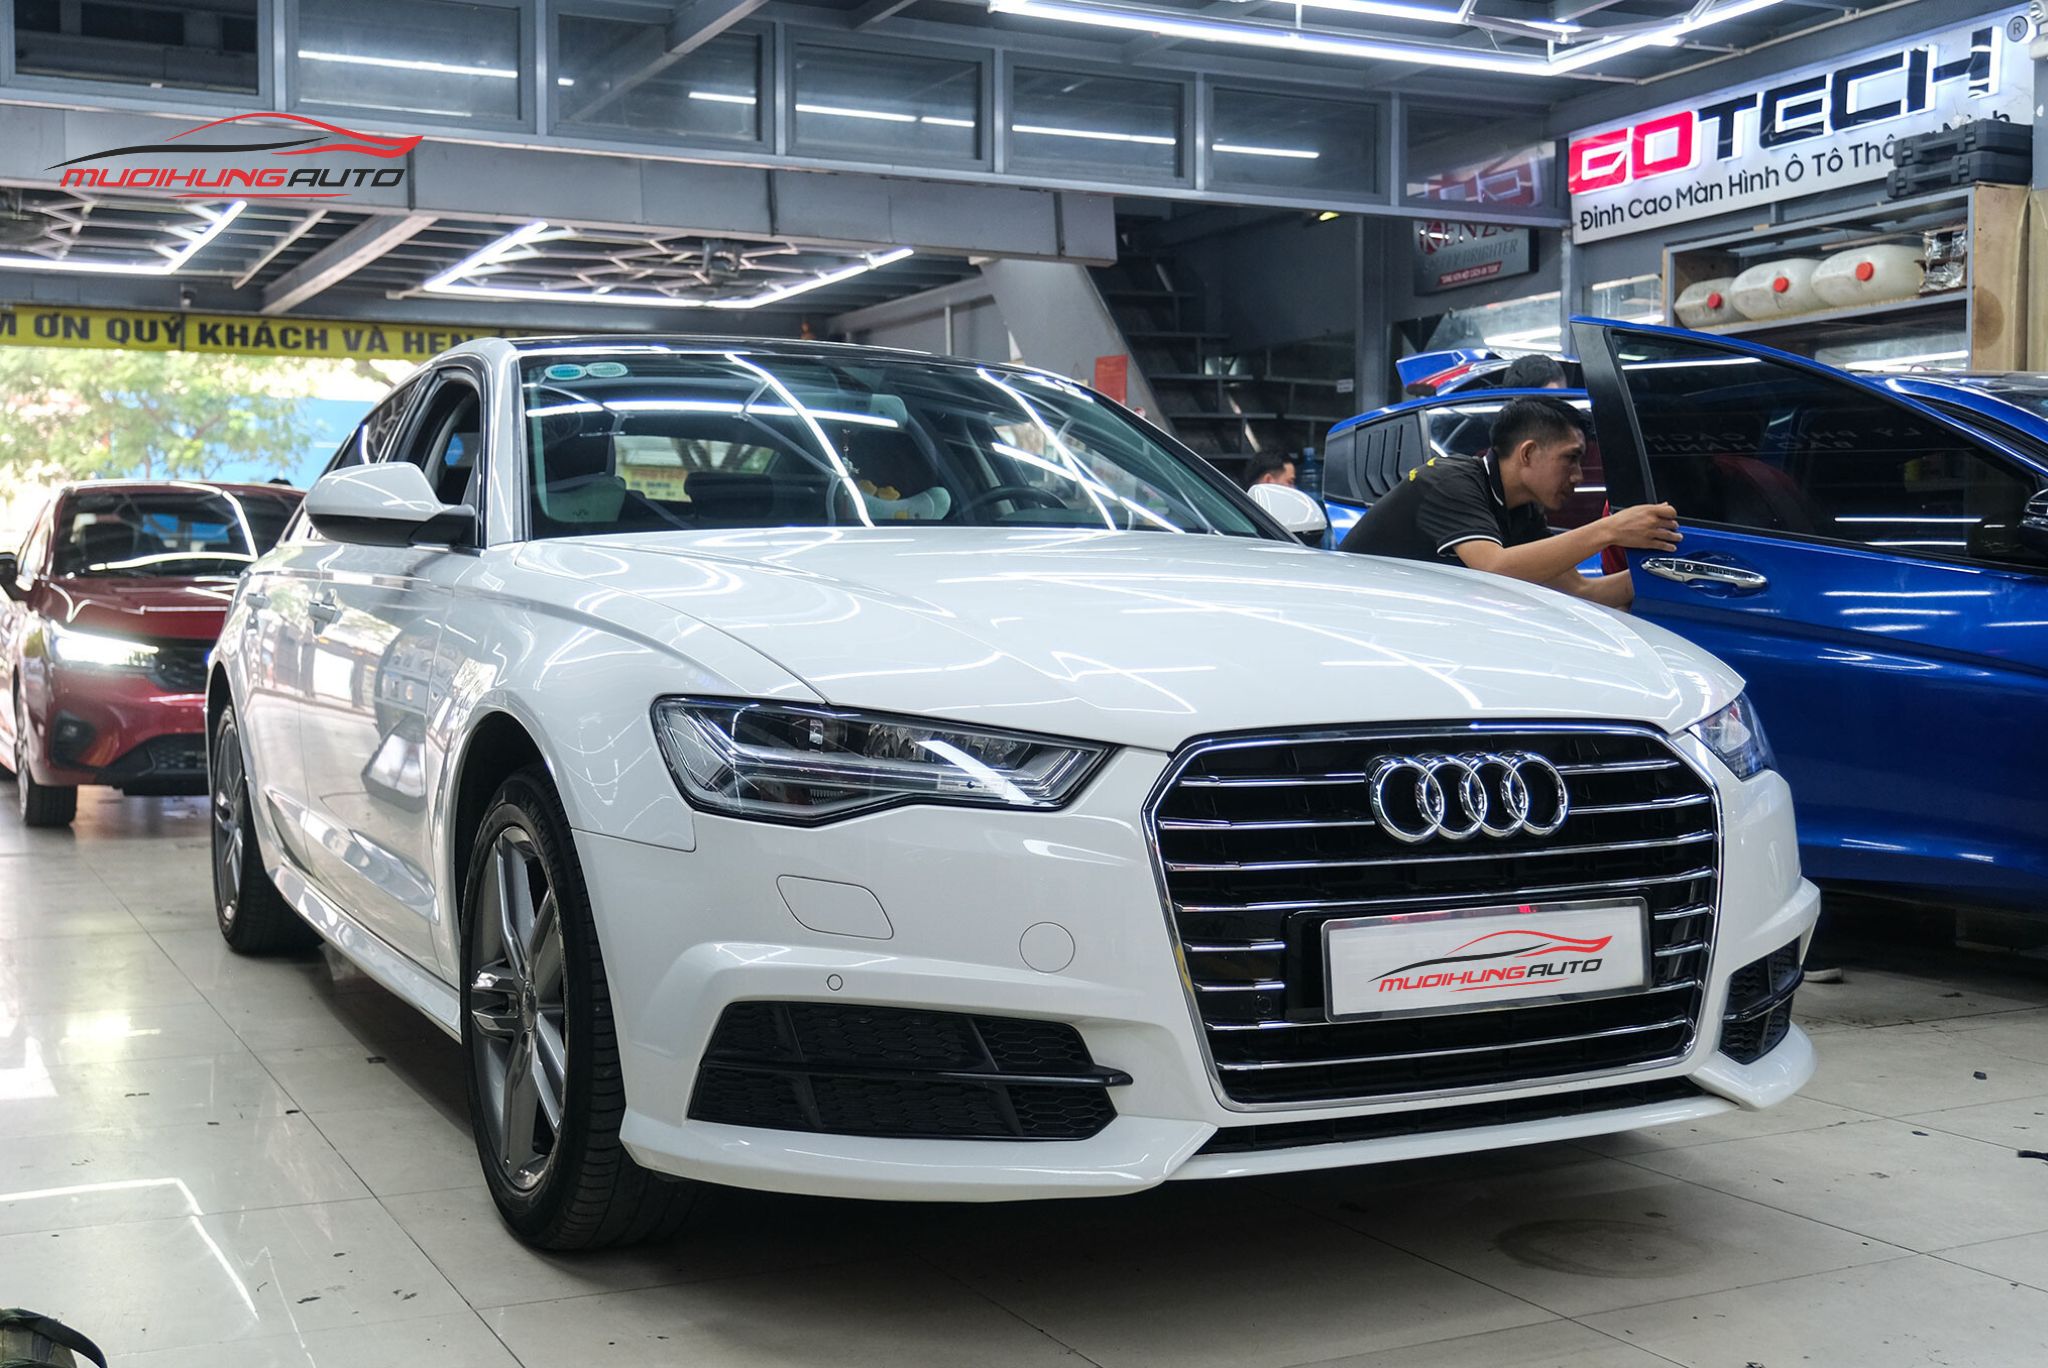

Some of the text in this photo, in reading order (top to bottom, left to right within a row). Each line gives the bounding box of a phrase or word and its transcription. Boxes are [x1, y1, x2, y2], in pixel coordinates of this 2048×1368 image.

[1628, 194, 1672, 219] Cao
[1676, 181, 1723, 209] Màn
[1729, 166, 1779, 196] Hình
[1785, 153, 1804, 182] Ô
[1812, 148, 1843, 176] Tô
[34, 312, 90, 340] ƠN
[107, 316, 183, 344] QUÝ
[199, 320, 328, 349] KHÁCH
[342, 325, 390, 353] VÀ
